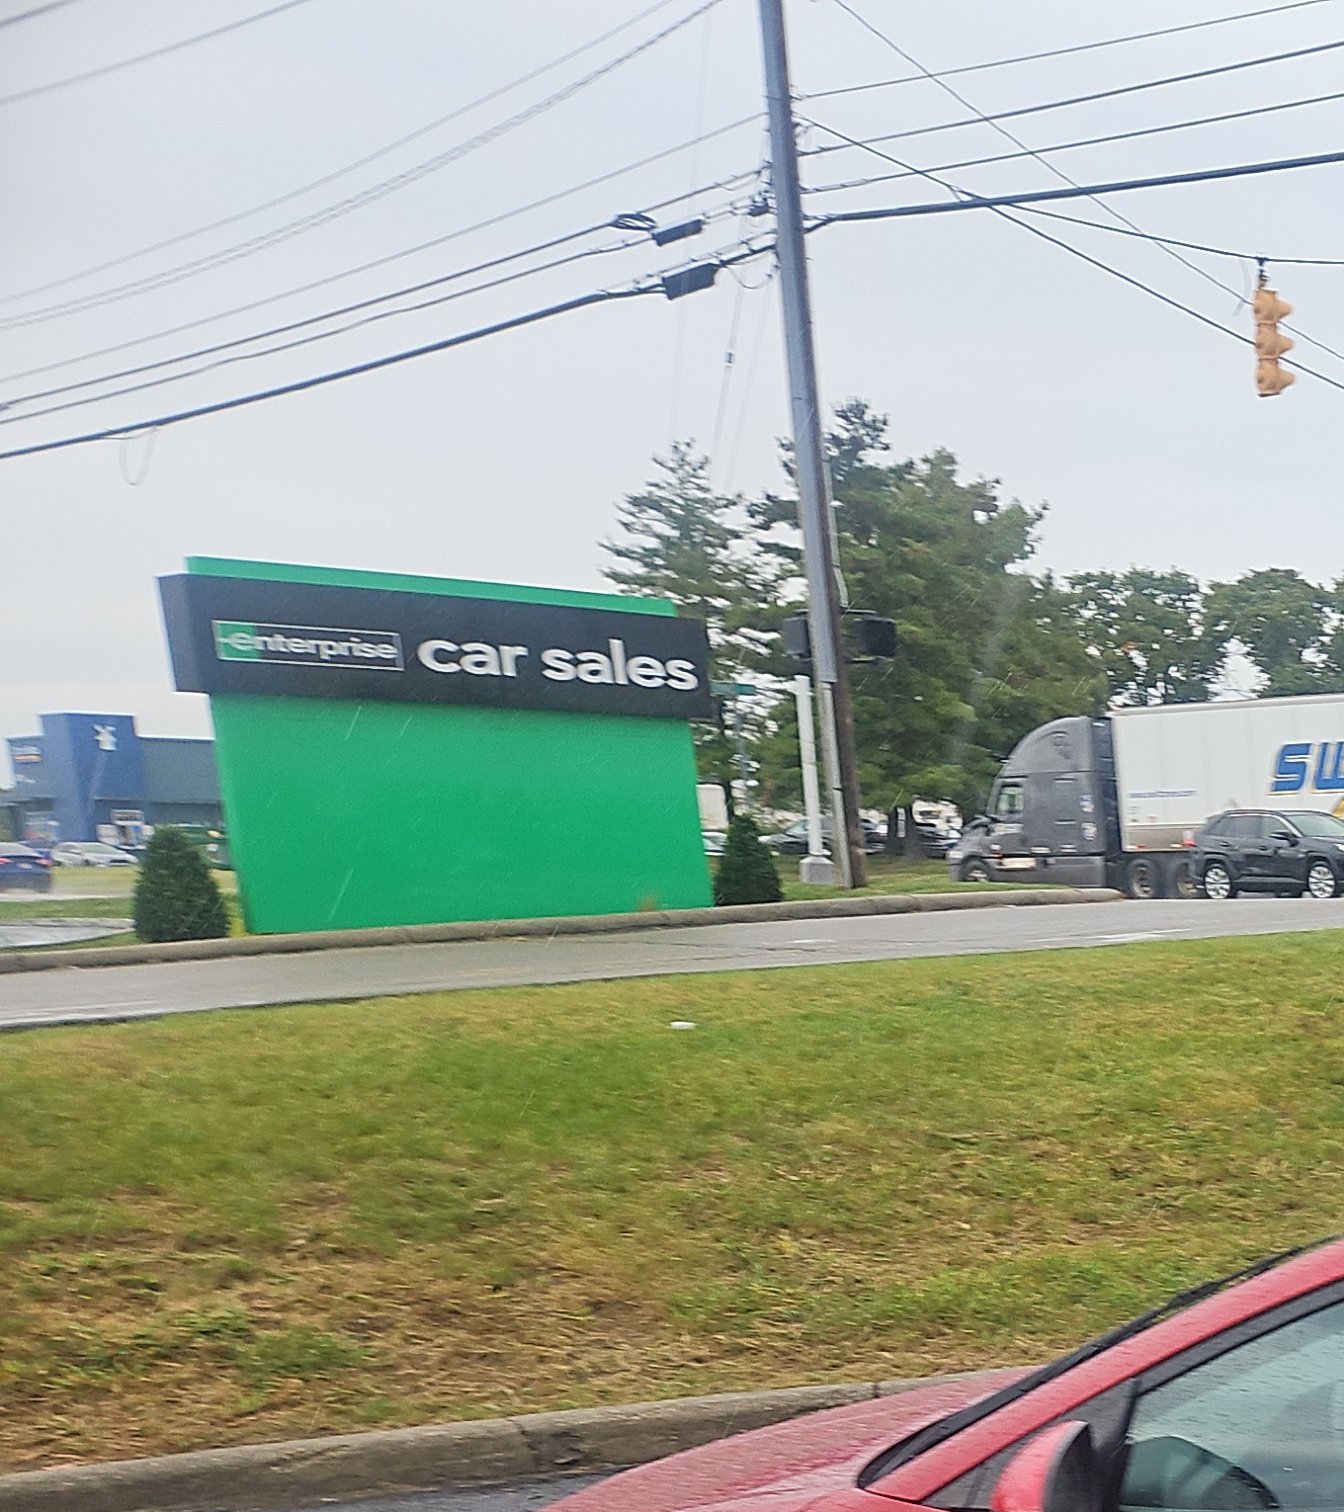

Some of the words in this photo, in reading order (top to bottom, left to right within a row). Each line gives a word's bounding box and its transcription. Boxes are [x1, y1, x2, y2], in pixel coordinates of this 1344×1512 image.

[219, 631, 399, 662] enterprise
[416, 638, 529, 678] car
[540, 637, 699, 691] sales
